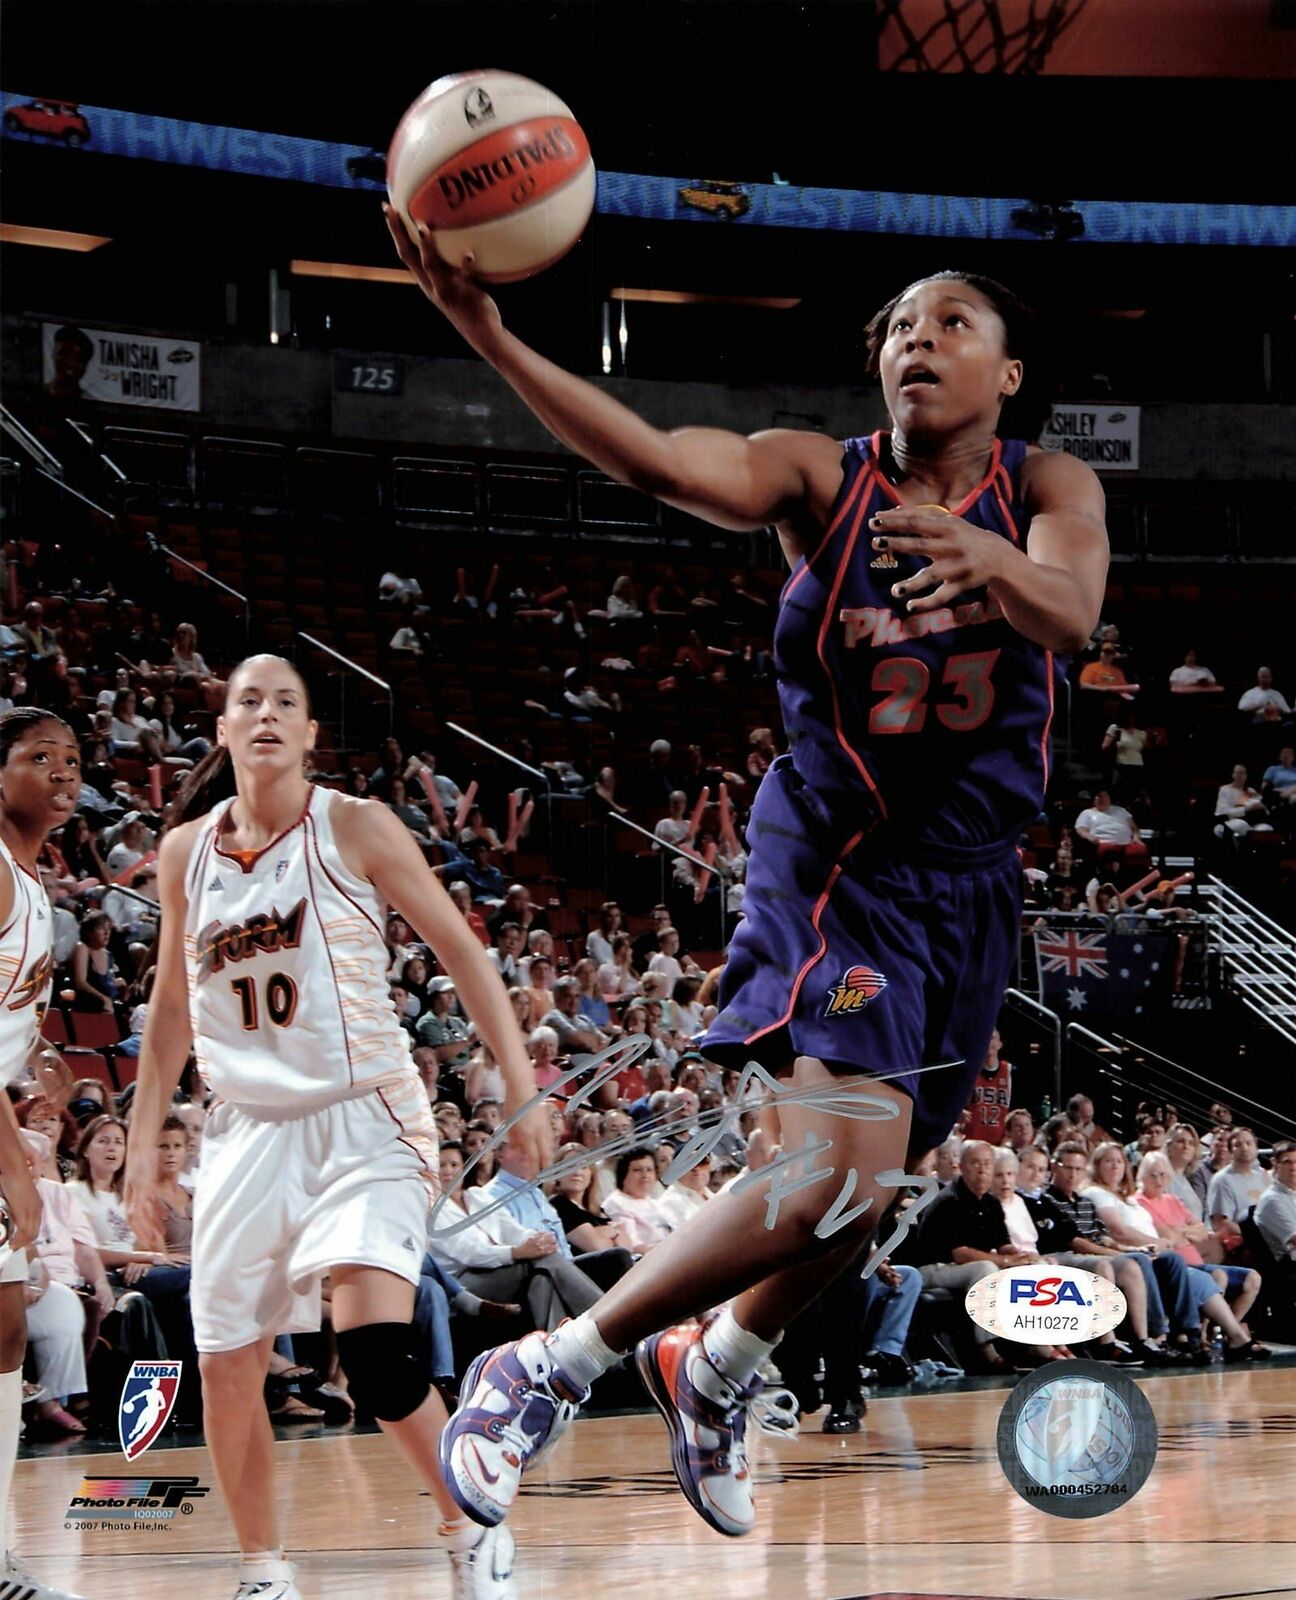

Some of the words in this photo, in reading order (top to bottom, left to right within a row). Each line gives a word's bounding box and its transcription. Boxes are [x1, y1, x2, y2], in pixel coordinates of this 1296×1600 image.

[438, 126, 576, 209] SPALDING
[1085, 203, 1296, 245] ORTHW
[98, 339, 159, 370] TANISHA
[120, 371, 178, 400] WRIGHT
[352, 366, 395, 389] 125
[869, 648, 1001, 735] 23
[197, 897, 308, 985] STORM
[231, 972, 298, 1031] 10
[980, 1106, 1000, 1126] 12
